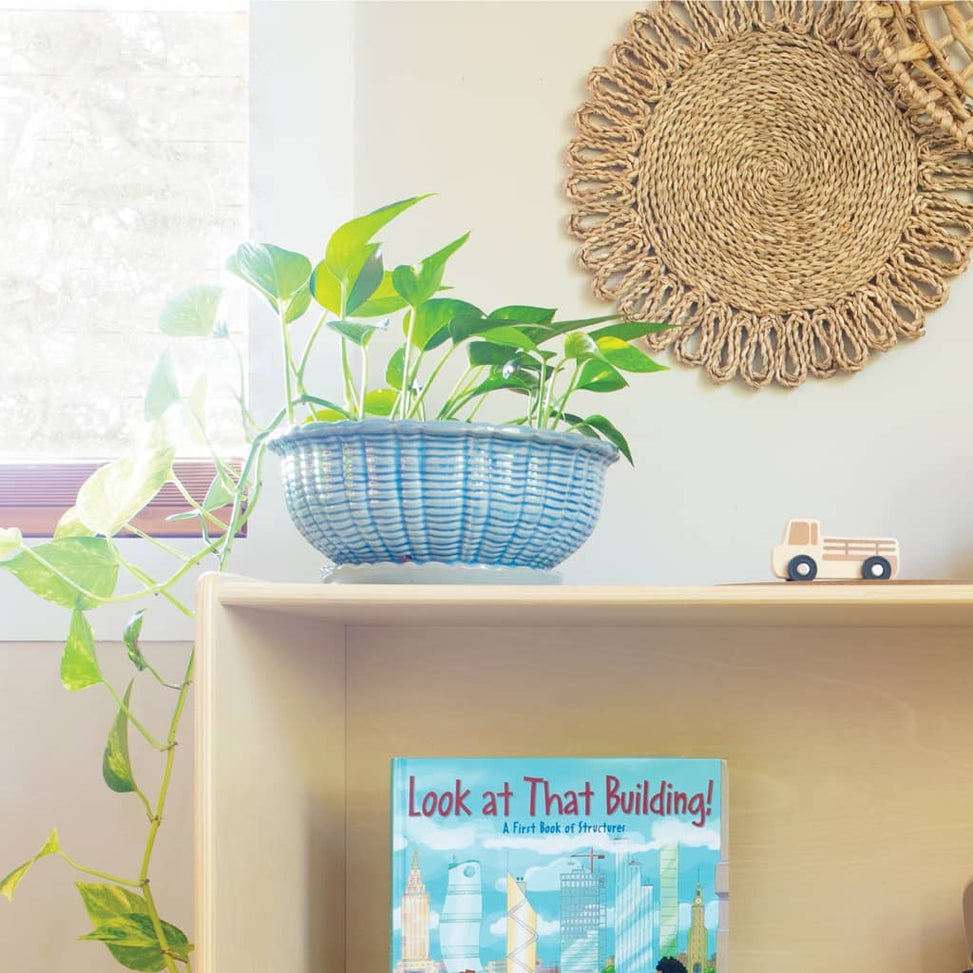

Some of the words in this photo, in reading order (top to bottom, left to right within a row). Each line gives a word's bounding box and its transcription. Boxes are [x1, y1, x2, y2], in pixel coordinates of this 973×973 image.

[408, 775, 473, 817] Look
[481, 781, 514, 816] at
[523, 776, 595, 816] That
[605, 774, 715, 828] Building!
[502, 821, 510, 834] A
[512, 821, 536, 834] First
[539, 821, 561, 834] Book
[564, 823, 576, 834] of
[578, 820, 626, 834] Structures
